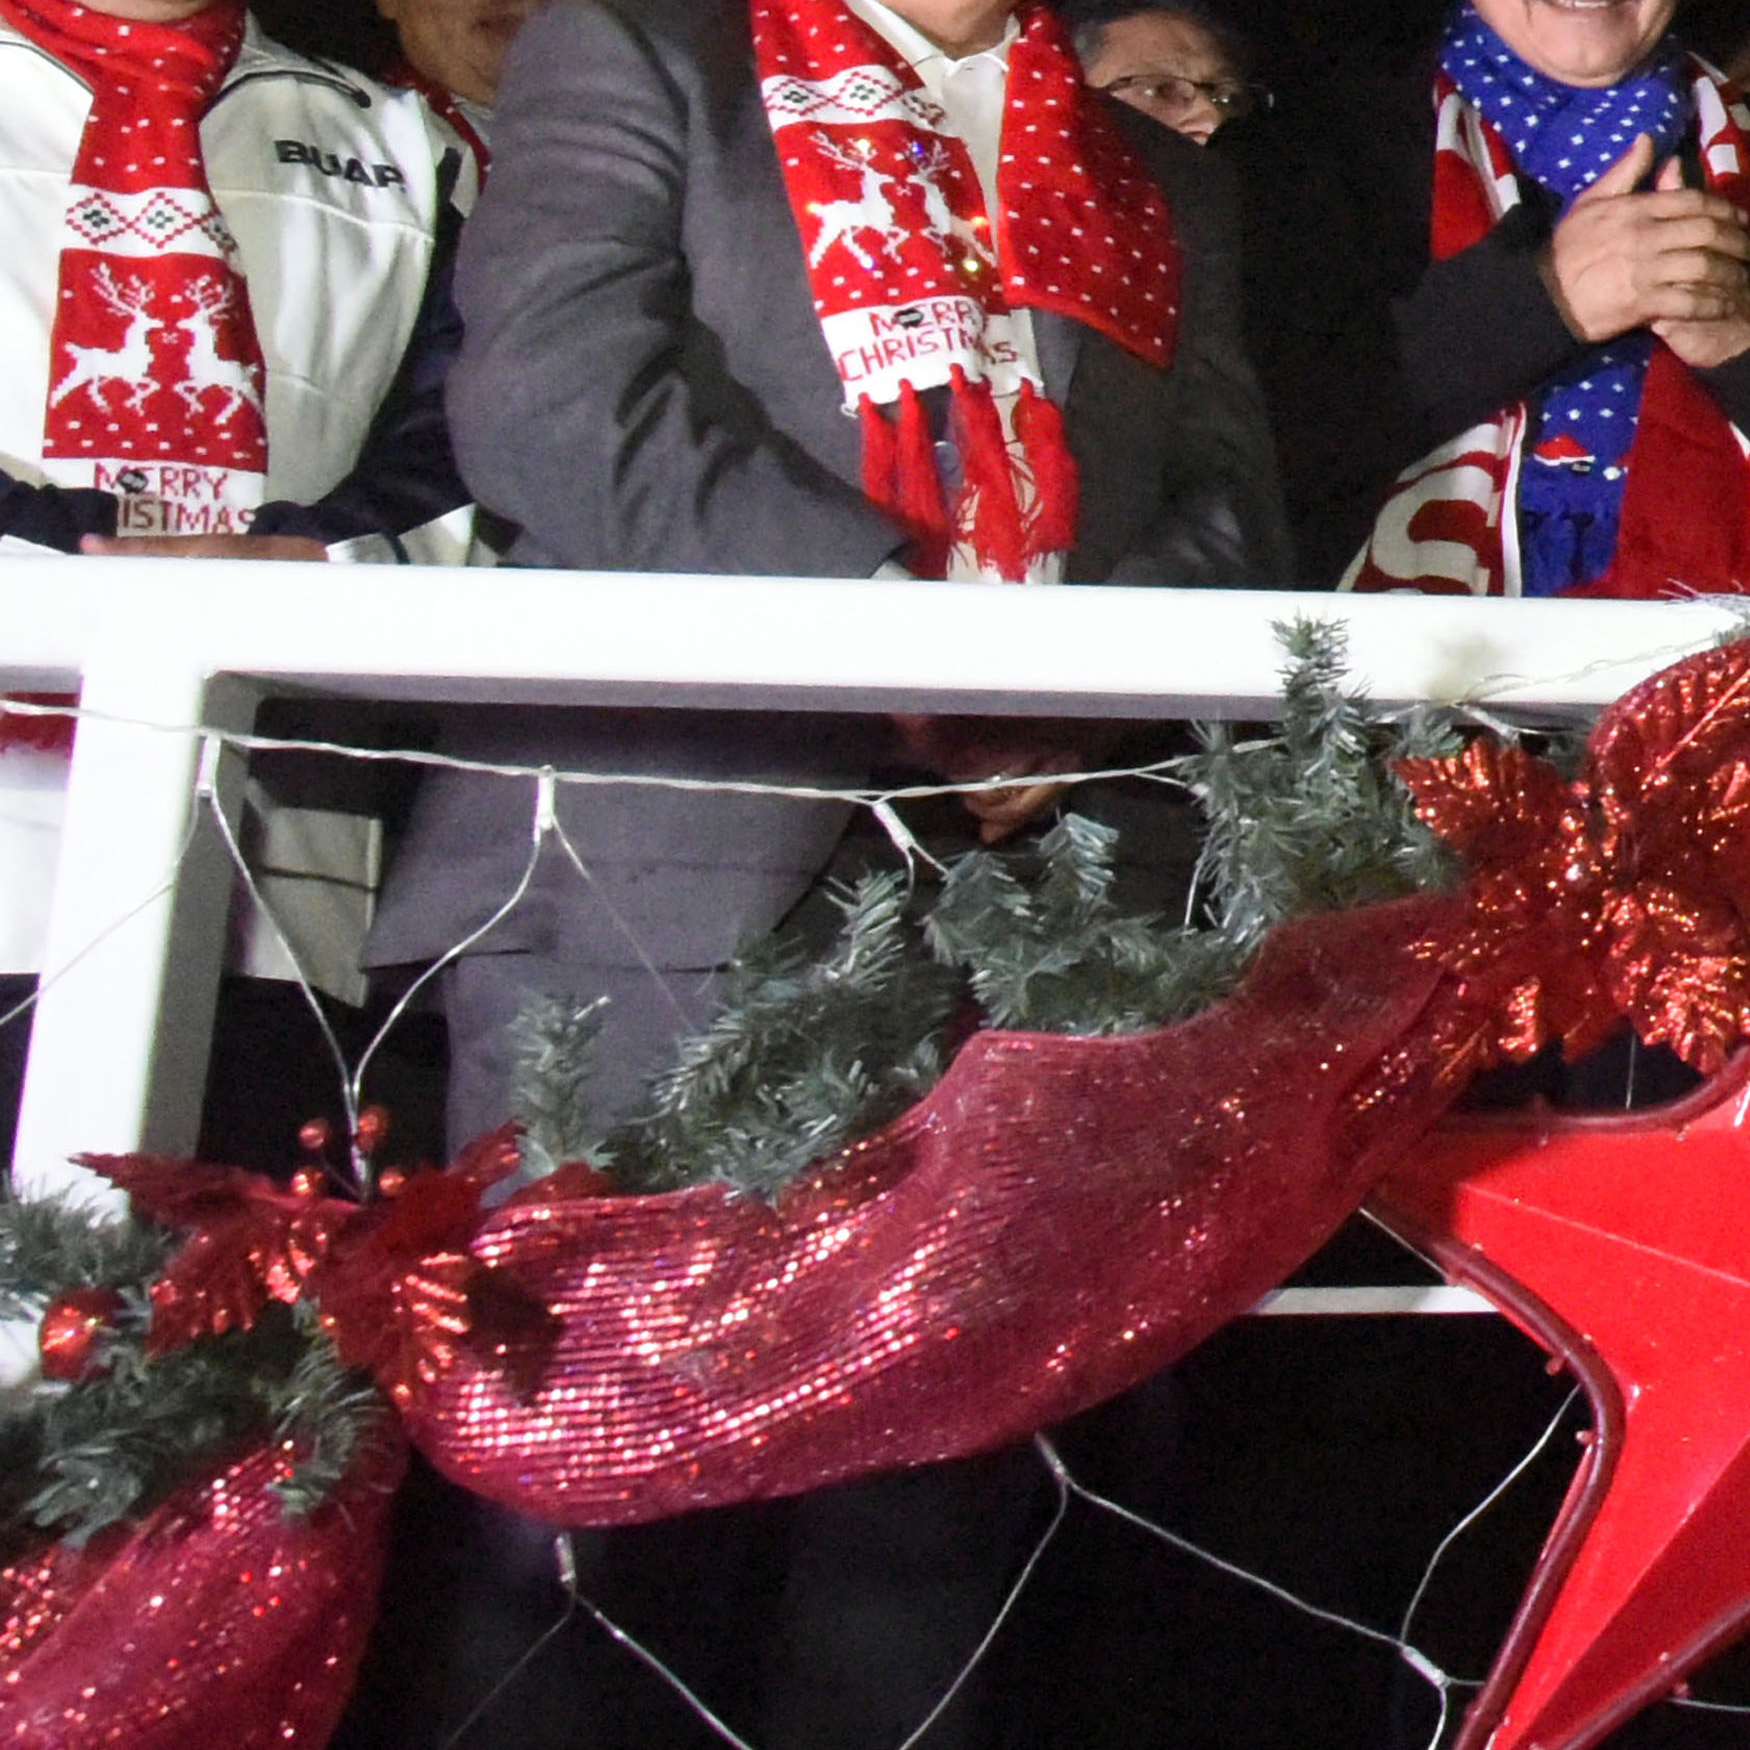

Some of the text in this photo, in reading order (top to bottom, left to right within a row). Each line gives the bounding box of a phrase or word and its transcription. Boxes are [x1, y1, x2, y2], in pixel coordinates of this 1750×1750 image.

[274, 139, 406, 194] BUAP
[868, 300, 978, 338] MERR
[94, 461, 229, 500] MERRY
